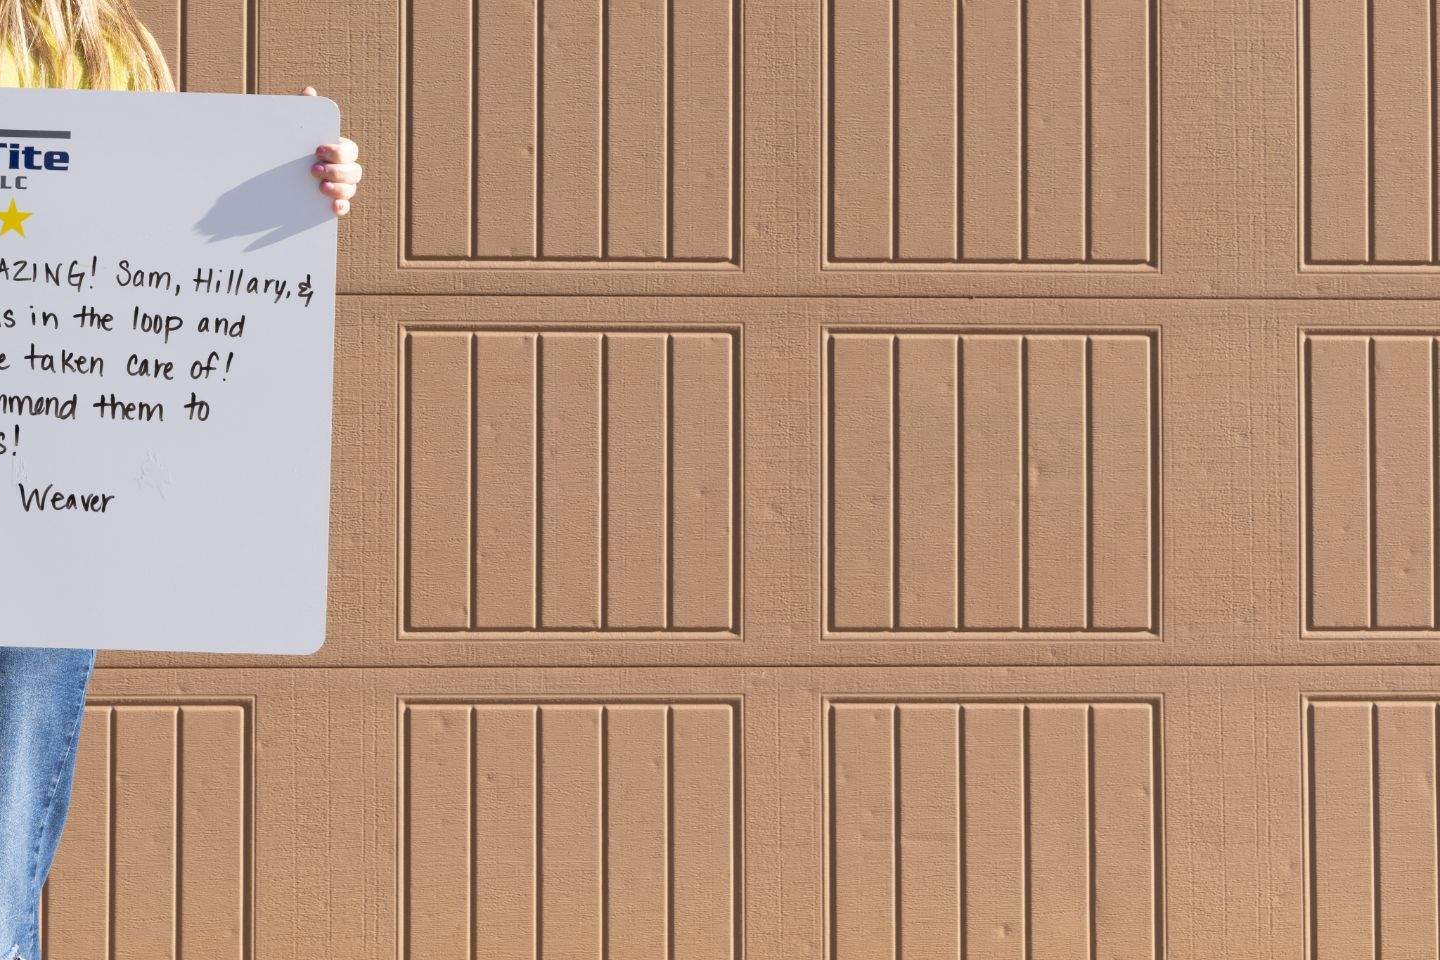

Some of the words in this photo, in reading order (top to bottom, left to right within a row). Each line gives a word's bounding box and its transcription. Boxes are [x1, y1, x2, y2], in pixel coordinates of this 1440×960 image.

[115, 259, 181, 297] Sam,
[192, 267, 291, 304] Hillary,
[297, 273, 314, 308] &
[29, 305, 59, 330] in
[72, 304, 114, 332] the
[132, 305, 184, 345] loop
[197, 314, 246, 338] and
[23, 342, 104, 378] taken
[126, 353, 174, 381] care
[189, 350, 234, 382] of!
[92, 393, 164, 422] them
[183, 391, 210, 422] to
[17, 482, 116, 514] Weaver
